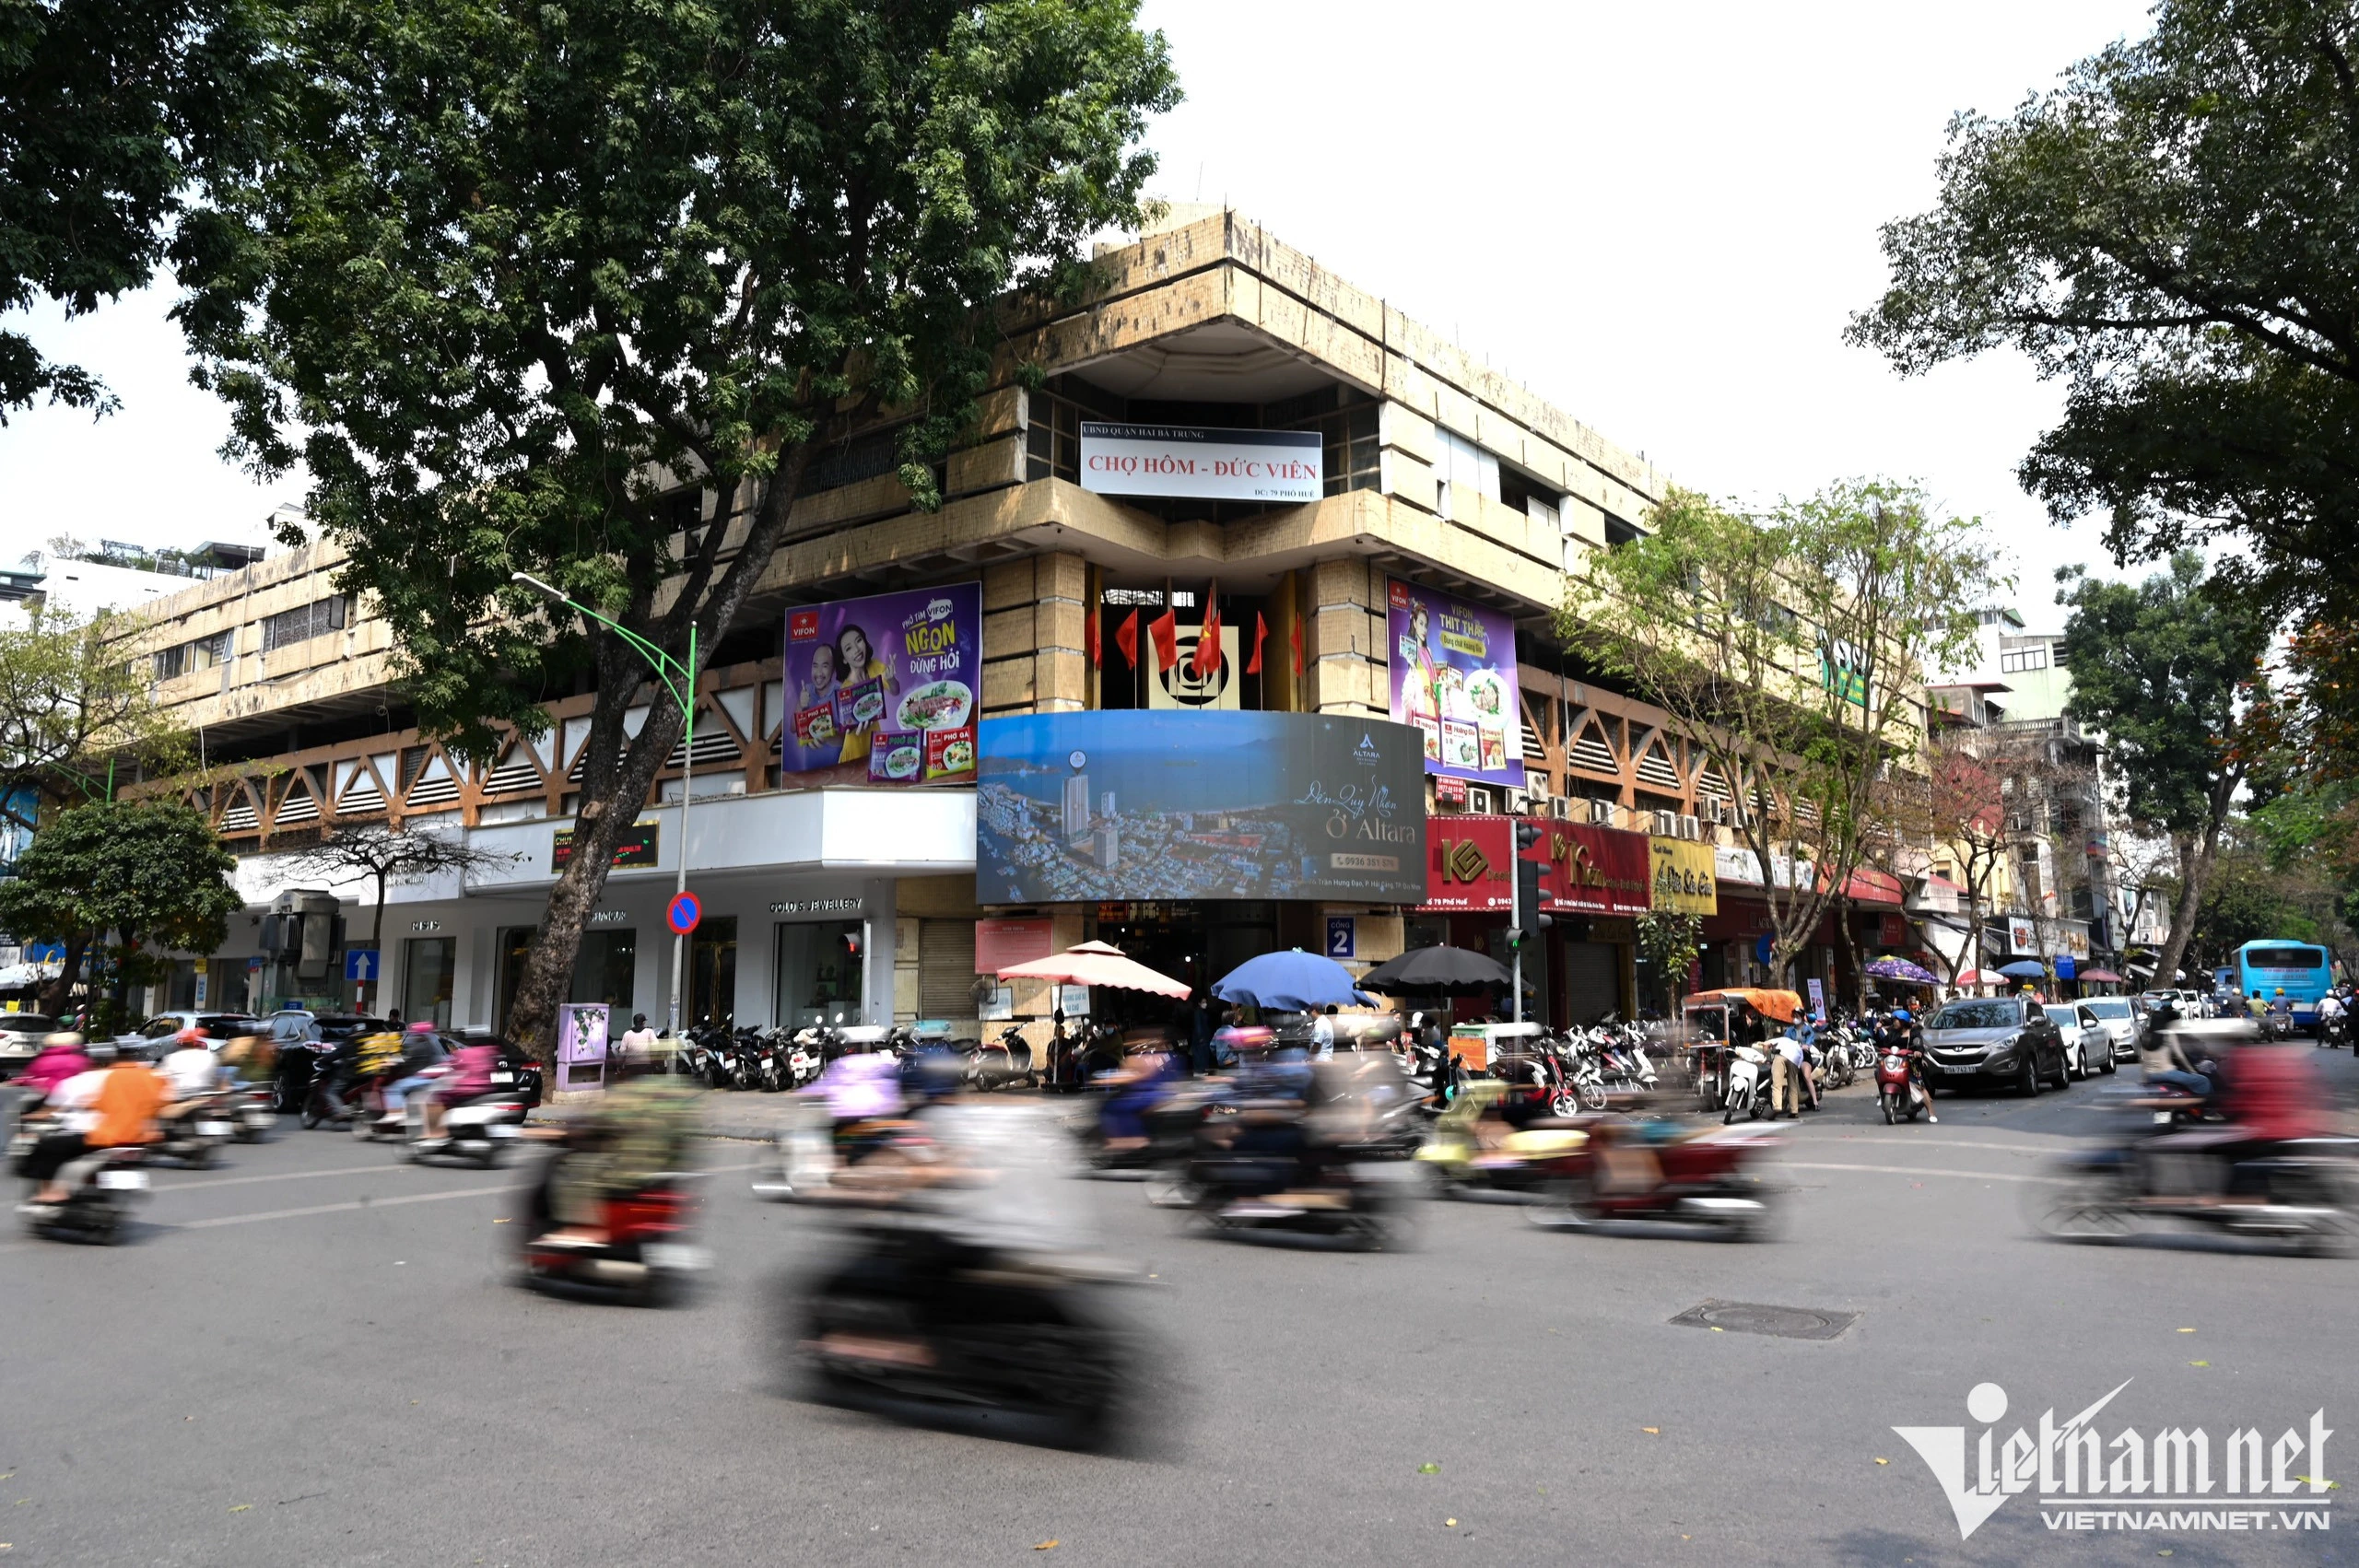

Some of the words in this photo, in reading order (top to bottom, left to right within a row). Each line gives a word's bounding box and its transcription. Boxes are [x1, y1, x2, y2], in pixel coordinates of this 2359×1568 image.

[1083, 427, 1109, 435] UBND
[1110, 427, 1136, 437] QUẬN
[1157, 427, 1169, 438] BÀ
[1173, 429, 1204, 439] TRƯNG
[1088, 455, 1138, 476] CHỢ
[1144, 454, 1195, 475] HÔM
[1214, 457, 1260, 477] ĐỨC
[1266, 460, 1317, 480] VIÊN
[1391, 595, 1407, 605] VIFON
[928, 604, 952, 617] VIFON
[1451, 603, 1473, 620] VIFON
[1439, 614, 1461, 633] THỊT
[793, 626, 815, 636] VIFON
[906, 620, 956, 655] NGON
[910, 657, 936, 673] ĐỪNG
[940, 648, 959, 670] HỎI
[1326, 808, 1347, 838] Ở
[1356, 818, 1415, 844] Altara
[1345, 857, 1365, 866] 0936
[1367, 858, 1379, 867] 351
[1333, 879, 1350, 888] Hưng
[769, 902, 796, 913] GOLD
[798, 902, 804, 911] &
[807, 898, 862, 911] JEWELLERY
[1456, 897, 1468, 906] Huế
[1331, 919, 1350, 929] CỔNG
[1333, 930, 1347, 953] 2
